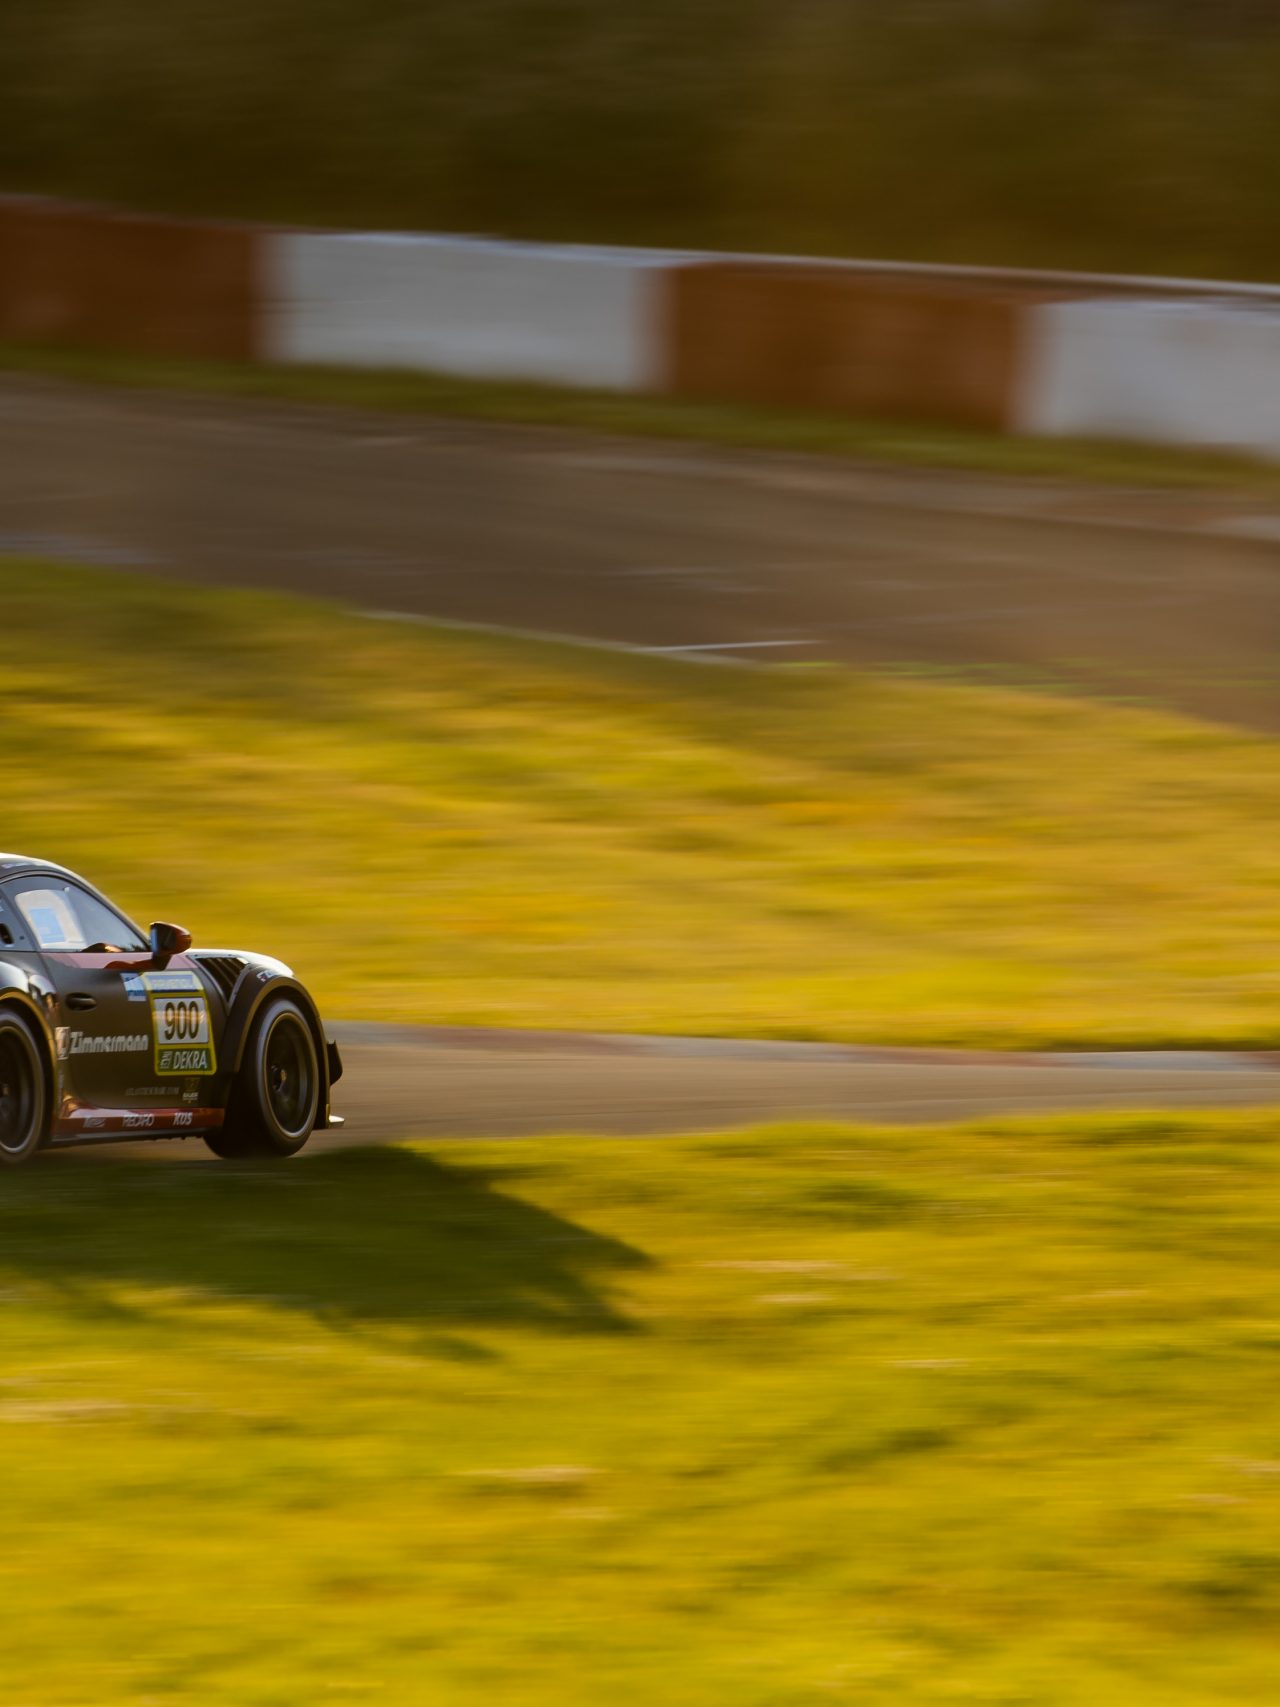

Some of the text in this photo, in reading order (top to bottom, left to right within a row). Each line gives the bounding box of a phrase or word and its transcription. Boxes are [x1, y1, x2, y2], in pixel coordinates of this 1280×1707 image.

[164, 1001, 199, 1040] 900
[71, 1032, 149, 1054] Zimmermann
[173, 1051, 208, 1070] DEKRA
